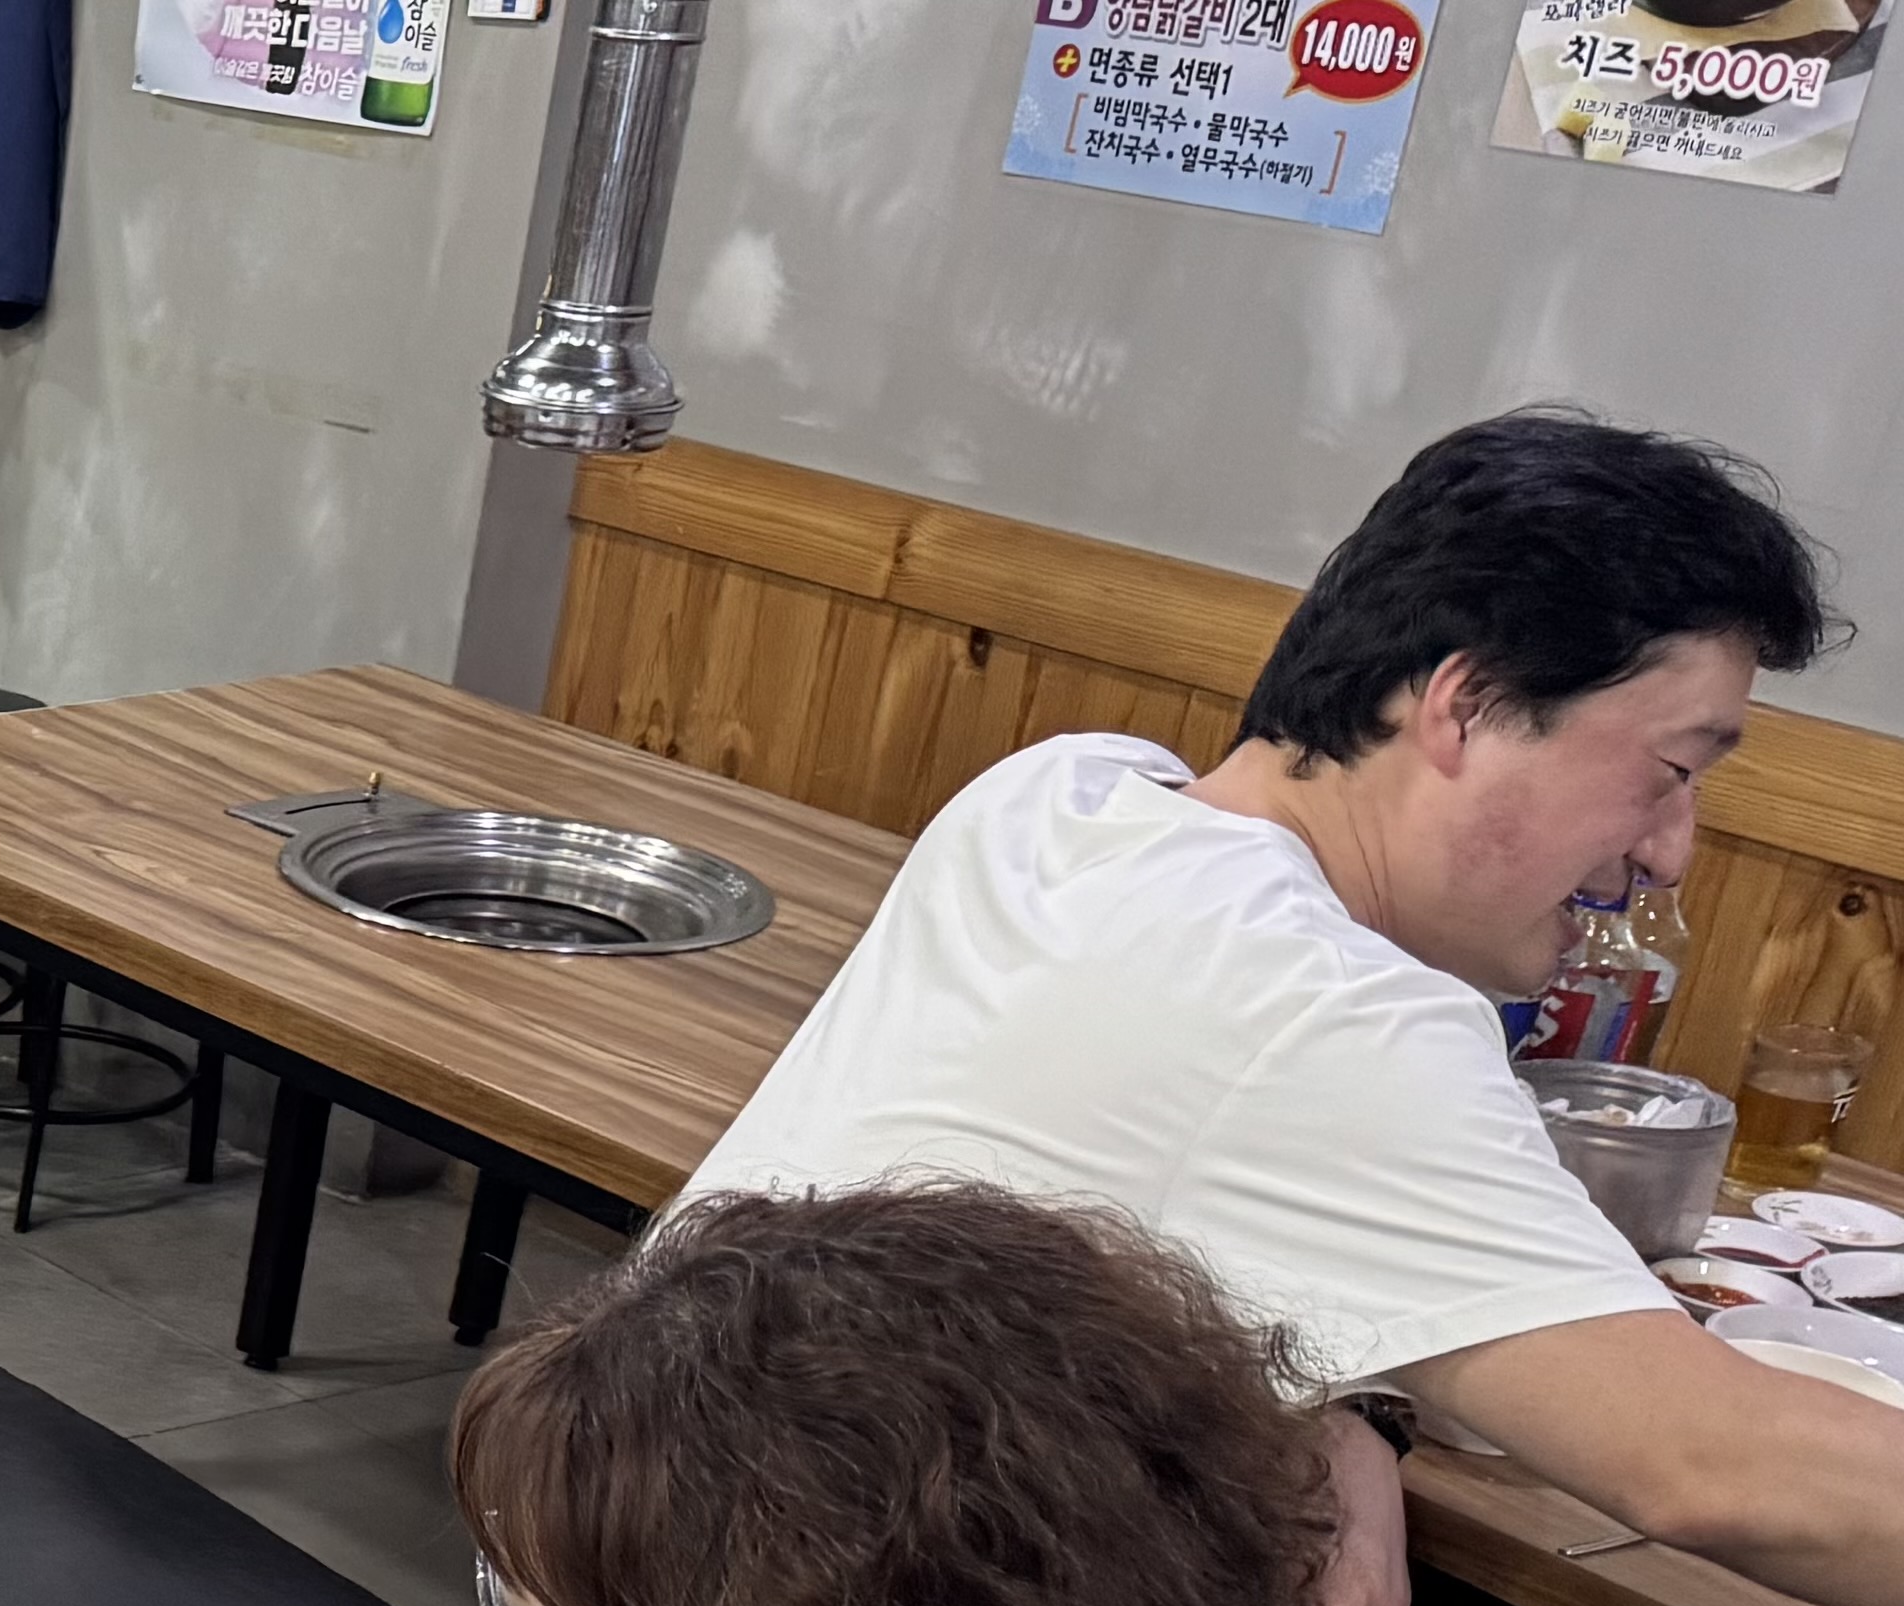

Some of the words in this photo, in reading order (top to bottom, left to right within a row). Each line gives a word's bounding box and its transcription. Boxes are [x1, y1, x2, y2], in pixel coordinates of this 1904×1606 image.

[221, 5, 291, 46] 깨끗한
[291, 14, 369, 55] 다음날
[404, 22, 437, 51] 이슬
[1301, 18, 1417, 74] 14,000원
[297, 61, 358, 101] 참이슬
[400, 56, 428, 72] fresh
[1088, 47, 1160, 89] 면종류
[1169, 57, 1233, 100] 선택1
[1561, 35, 1634, 78] 치즈
[1655, 45, 1821, 99] 5,000원
[1084, 128, 1161, 165] 잔치국수
[1093, 96, 1188, 135] 비빔막국수
[1207, 112, 1290, 149] 물막국수
